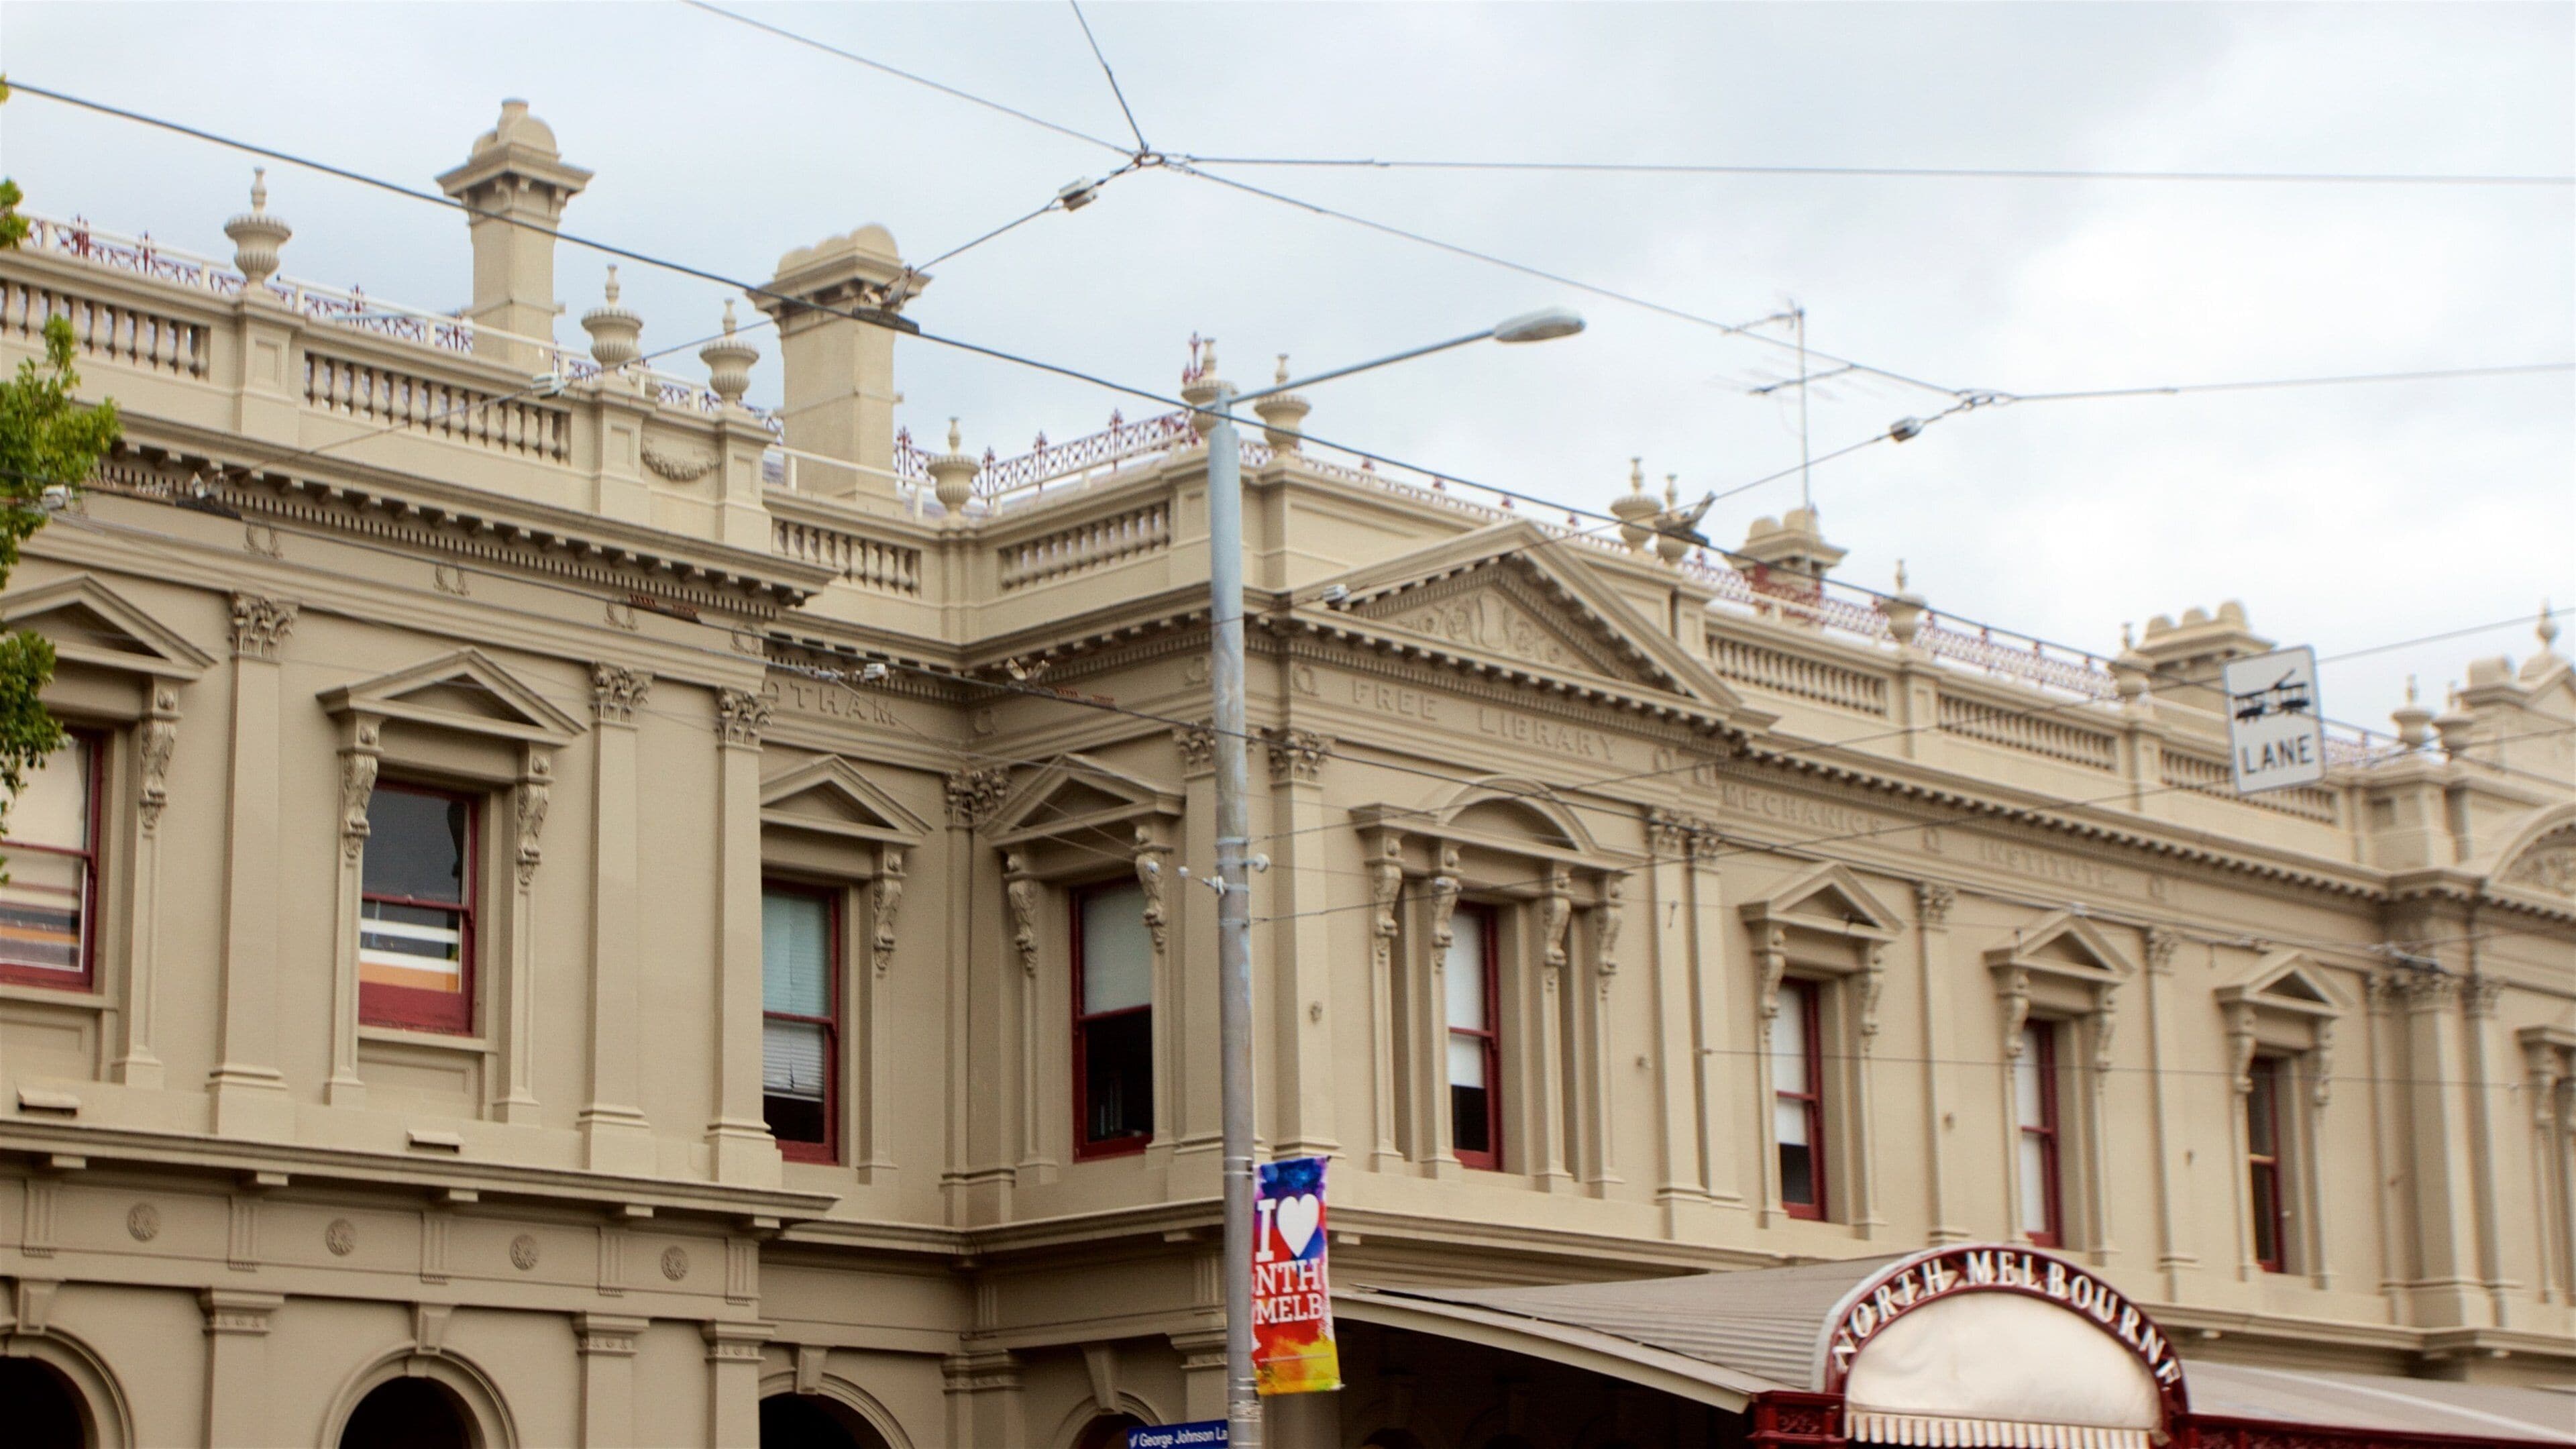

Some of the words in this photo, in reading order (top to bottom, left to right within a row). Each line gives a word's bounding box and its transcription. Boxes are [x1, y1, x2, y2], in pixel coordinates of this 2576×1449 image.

[1351, 679, 1438, 722] FREE
[1478, 706, 1615, 761] LIBRARY
[2241, 733, 2314, 775] LANE
[1255, 1198, 1277, 1263] I
[1255, 1258, 1322, 1297] NTH
[1256, 1293, 1324, 1325] MELB
[1832, 1258, 1945, 1373] NORTH
[1966, 1250, 2182, 1391] MELBOURNE
[1139, 1432, 1174, 1448] George
[1175, 1429, 1215, 1444] Johnson
